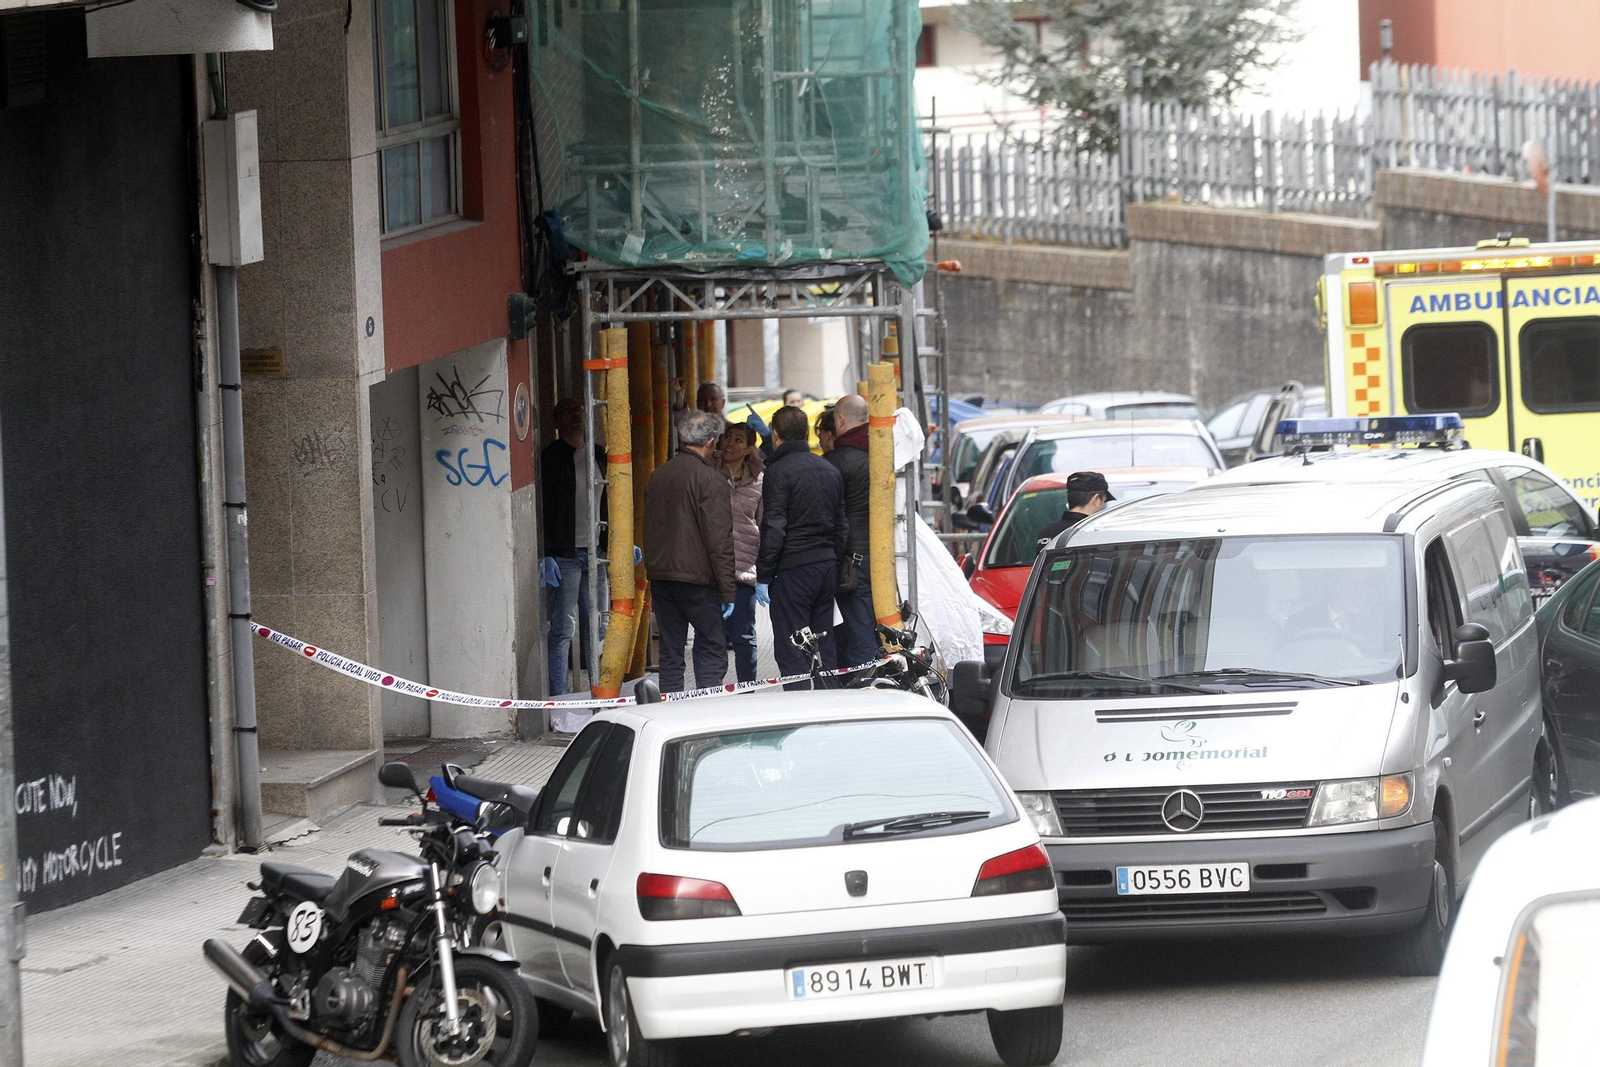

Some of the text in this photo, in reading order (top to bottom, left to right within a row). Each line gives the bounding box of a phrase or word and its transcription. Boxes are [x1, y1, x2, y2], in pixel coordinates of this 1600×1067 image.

[1409, 286, 1600, 313] AMBULANCIA
[270, 632, 304, 652] NO PASAR
[316, 651, 382, 682] POLICIA LOCAL VIGO
[393, 680, 427, 695] NO PASAR
[1133, 868, 1191, 890] 0556
[1199, 867, 1243, 888] BVC
[290, 909, 318, 942] 83
[810, 967, 872, 993] 8914
[881, 963, 926, 988] BWT
